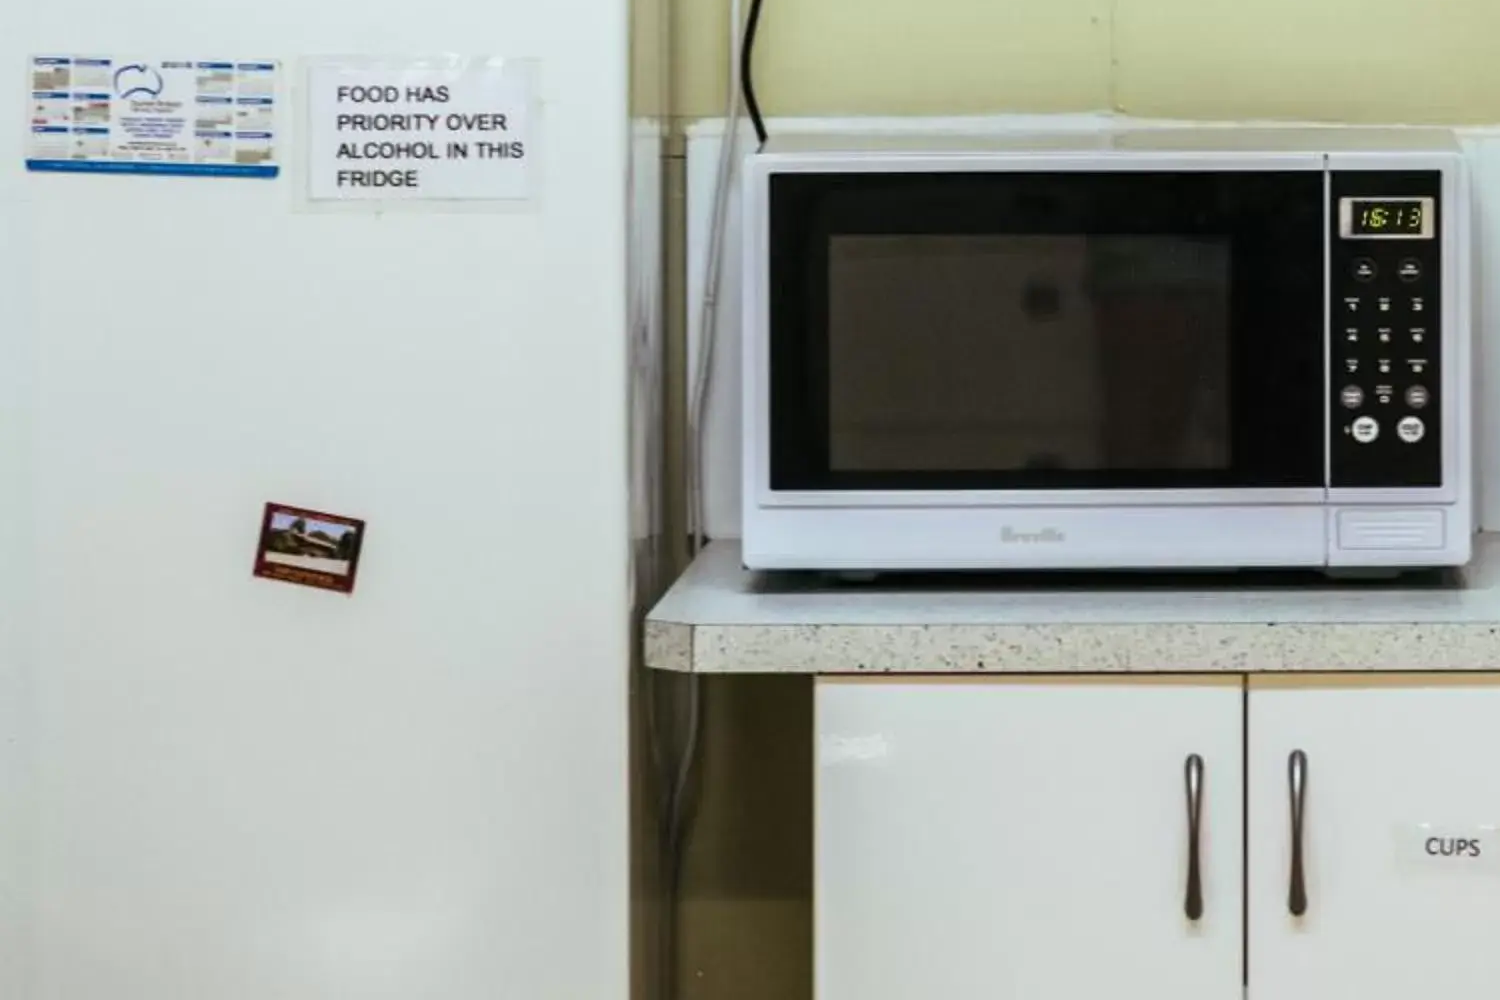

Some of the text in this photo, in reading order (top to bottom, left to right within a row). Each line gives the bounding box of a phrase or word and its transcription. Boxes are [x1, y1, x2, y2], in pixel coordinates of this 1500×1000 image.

[336, 85, 451, 103] FOOD HAS
[336, 113, 508, 132] PRIORITY OVER
[335, 141, 525, 160] ALCOHOL IN THIS
[336, 169, 419, 188] FRIDGE
[1424, 836, 1482, 858] CUPS
